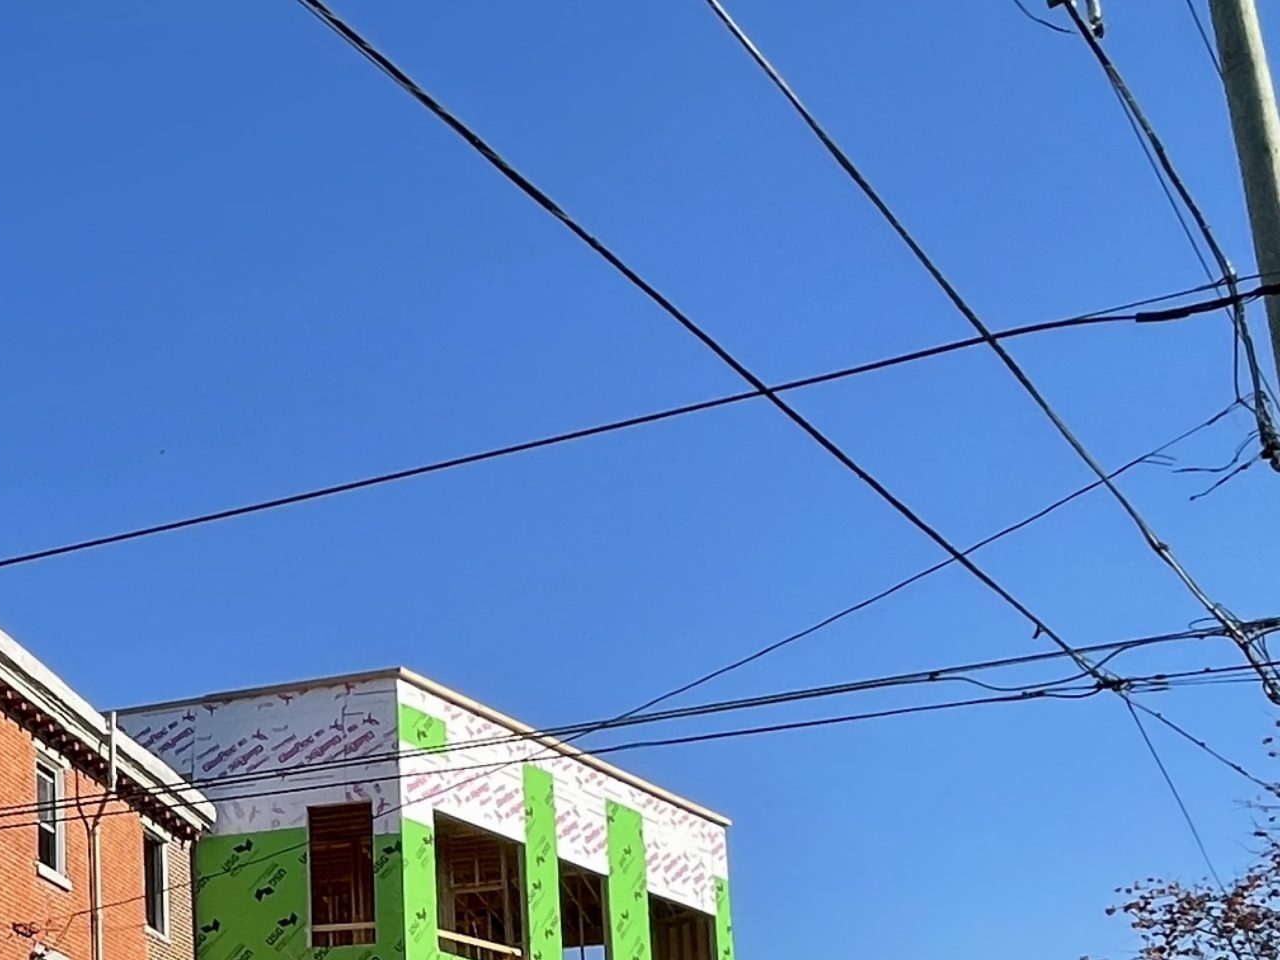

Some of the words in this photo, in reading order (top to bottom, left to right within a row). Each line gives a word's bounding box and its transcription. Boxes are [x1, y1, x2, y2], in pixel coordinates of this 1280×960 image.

[222, 853, 240, 873] USG
[268, 867, 287, 888] USG
[265, 928, 284, 946] USG
